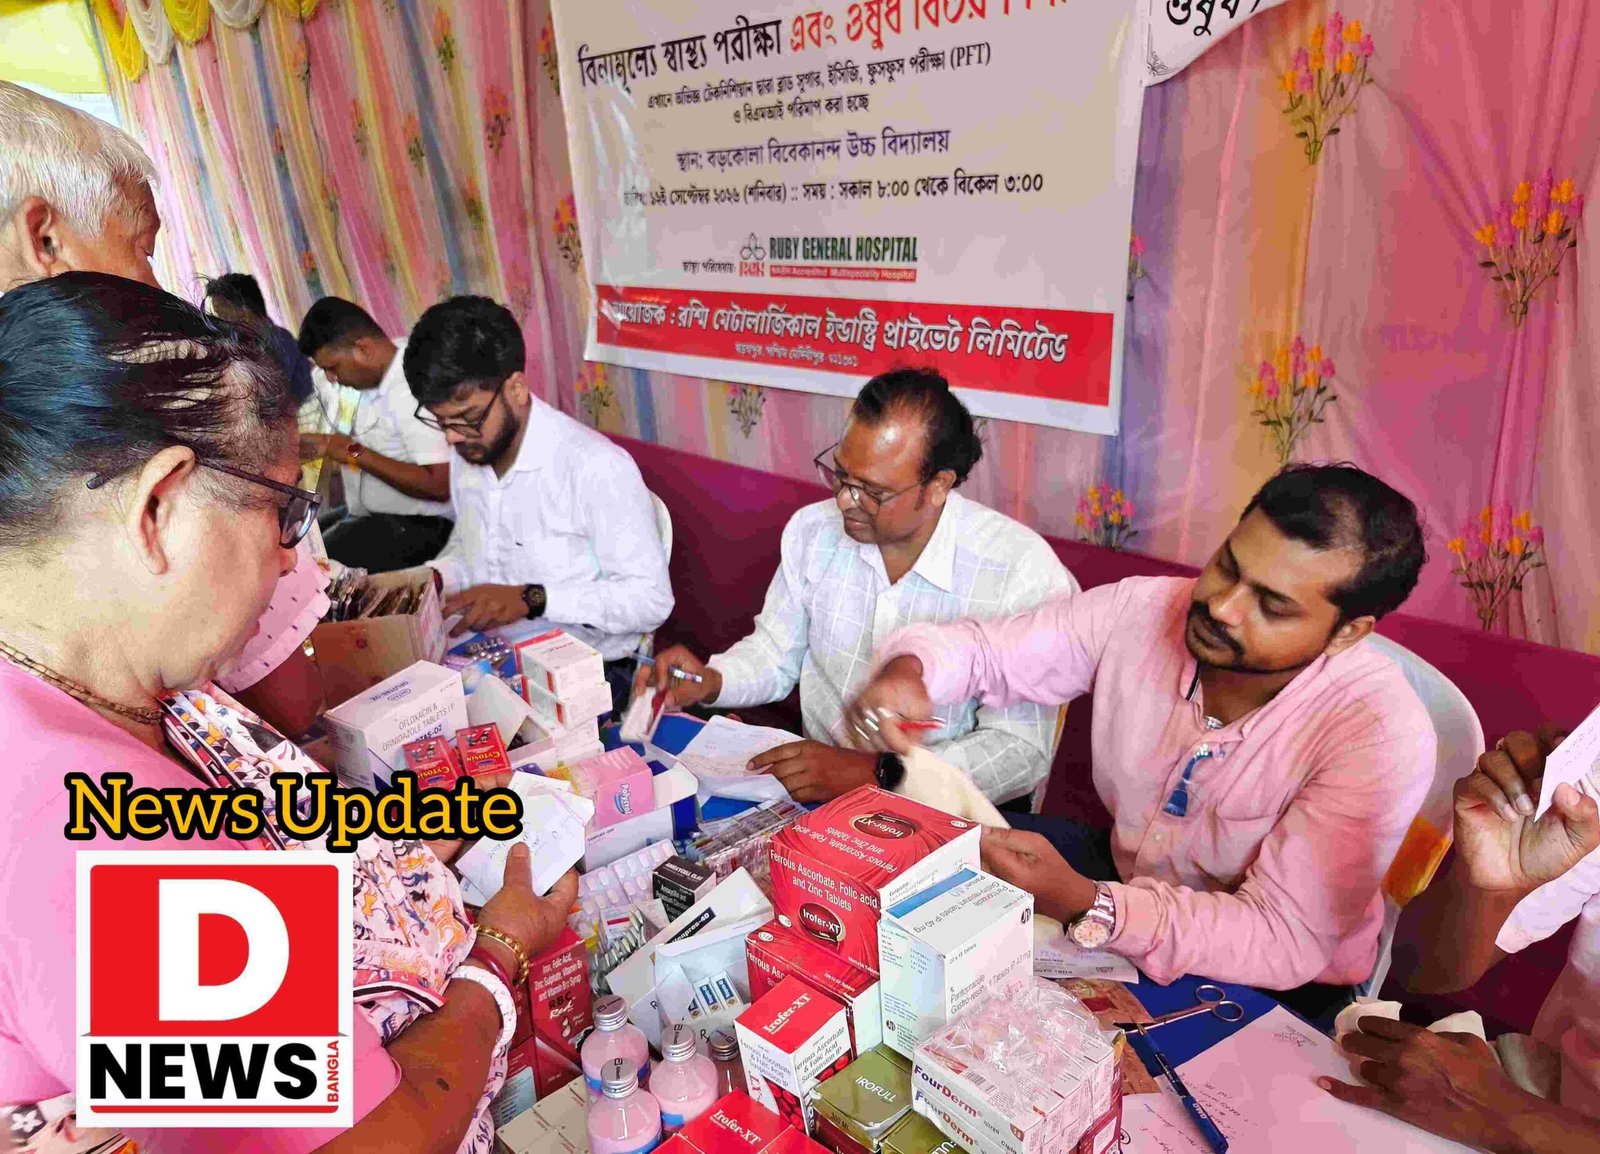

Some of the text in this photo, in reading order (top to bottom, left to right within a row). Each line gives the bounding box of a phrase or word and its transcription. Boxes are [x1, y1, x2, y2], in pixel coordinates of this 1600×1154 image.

[578, 44, 657, 94] বিনামূল্যে
[662, 35, 706, 72] স্বাস্থ্য
[714, 15, 782, 64] পরীক্ষা
[790, 11, 837, 52] এবং
[910, 47, 945, 73] পরীক্ষা
[950, 42, 991, 70] (PFT)
[768, 137, 841, 165] বিবেকানন্দ
[847, 129, 876, 157] উচ্চ
[839, 181, 872, 200] সকাল
[915, 176, 949, 197] থেকে
[954, 168, 999, 196] বিকেল
[769, 237, 918, 263] RUBY GENERAL HOSPITAL
[883, 313, 962, 354] প্রাইভেট
[967, 316, 1068, 363] লিমিটেড
[399, 705, 432, 730] OFLOXACIN
[383, 723, 422, 751] ORNIDAZOLE
[792, 824, 810, 836] acid
[809, 831, 827, 843] Folic
[825, 826, 850, 842] Tablets
[868, 844, 885, 855] and
[868, 856, 898, 873] Ferrous
[771, 850, 796, 871] Ferrous
[840, 882, 858, 899] Folic
[860, 893, 878, 909] acid
[793, 877, 852, 911] and Zinc Tablets
[803, 909, 840, 935] Irofer-XT
[746, 949, 770, 972] Ferrous
[549, 990, 573, 1009] RBC
[763, 993, 812, 1033] Irofer-XT
[816, 1026, 845, 1054] Ascorbate
[810, 1053, 825, 1069] Folic
[824, 1041, 838, 1057] Acid
[801, 1055, 835, 1084] Suspension
[855, 1076, 897, 1103] IROFULL
[712, 1109, 761, 1145] Irofer-XT
